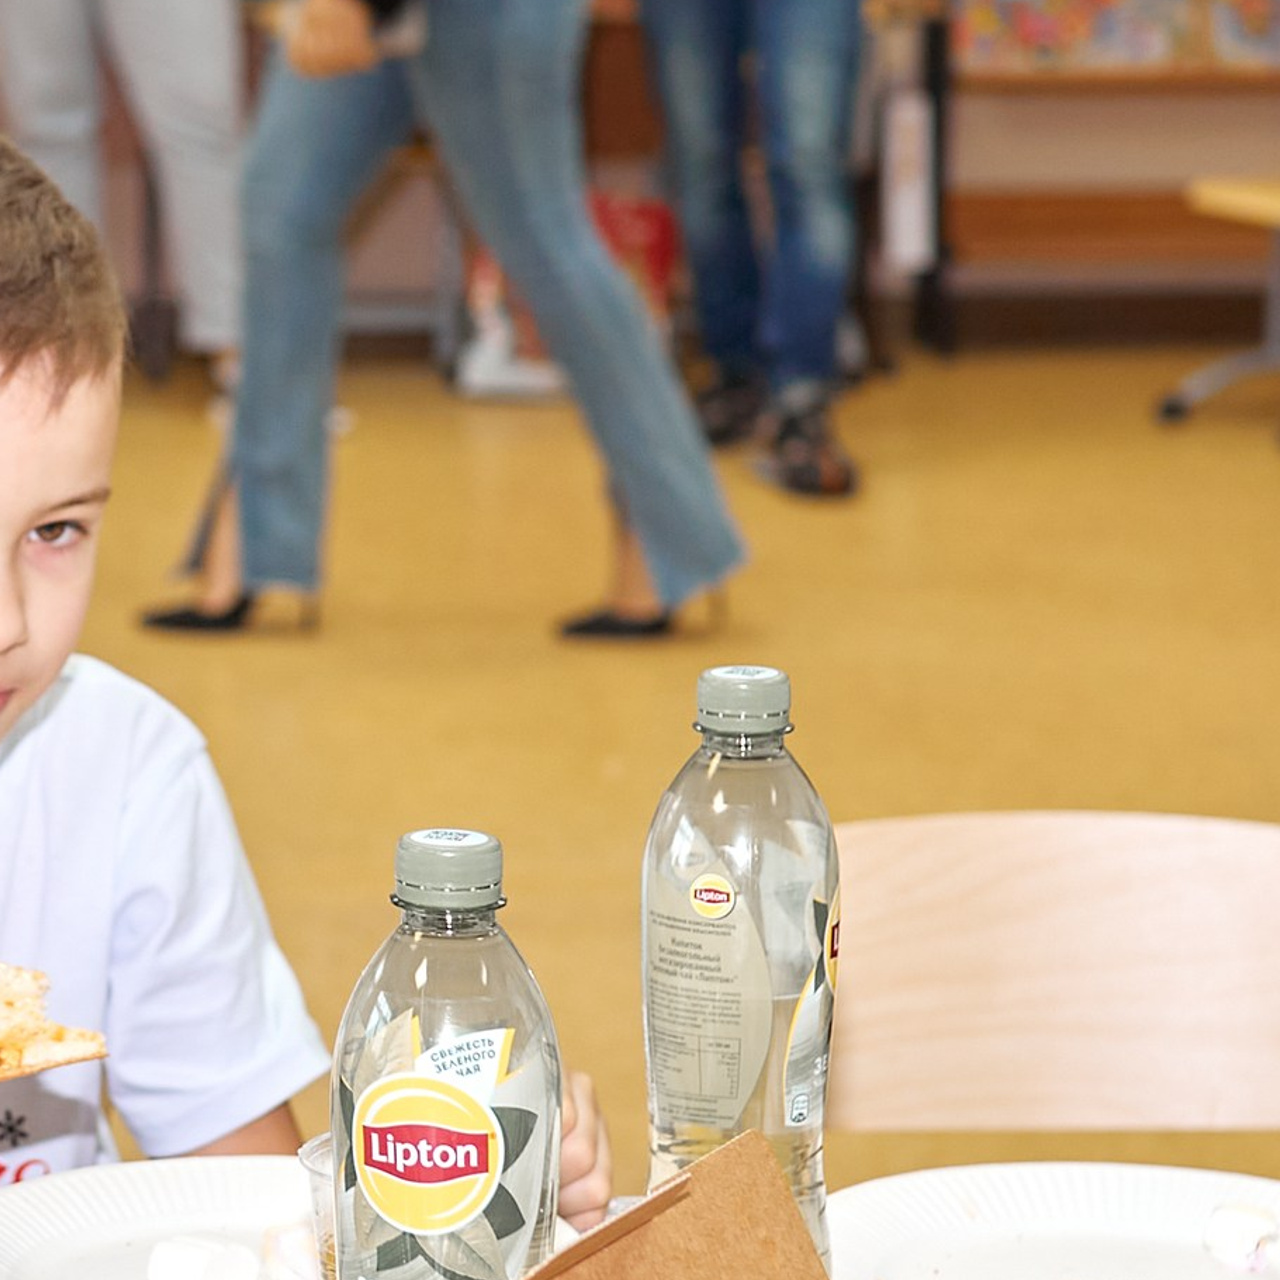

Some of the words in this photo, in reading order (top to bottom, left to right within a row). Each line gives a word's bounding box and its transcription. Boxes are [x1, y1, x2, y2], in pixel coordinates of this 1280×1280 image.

[695, 889, 728, 902] Lipton
[430, 1039, 495, 1062] СВЕЖЕСТЬ
[435, 1049, 496, 1074] ЗЕЛЕНОГО
[456, 1064, 481, 1077] ЧАЯ
[371, 1132, 478, 1173] Lipton
